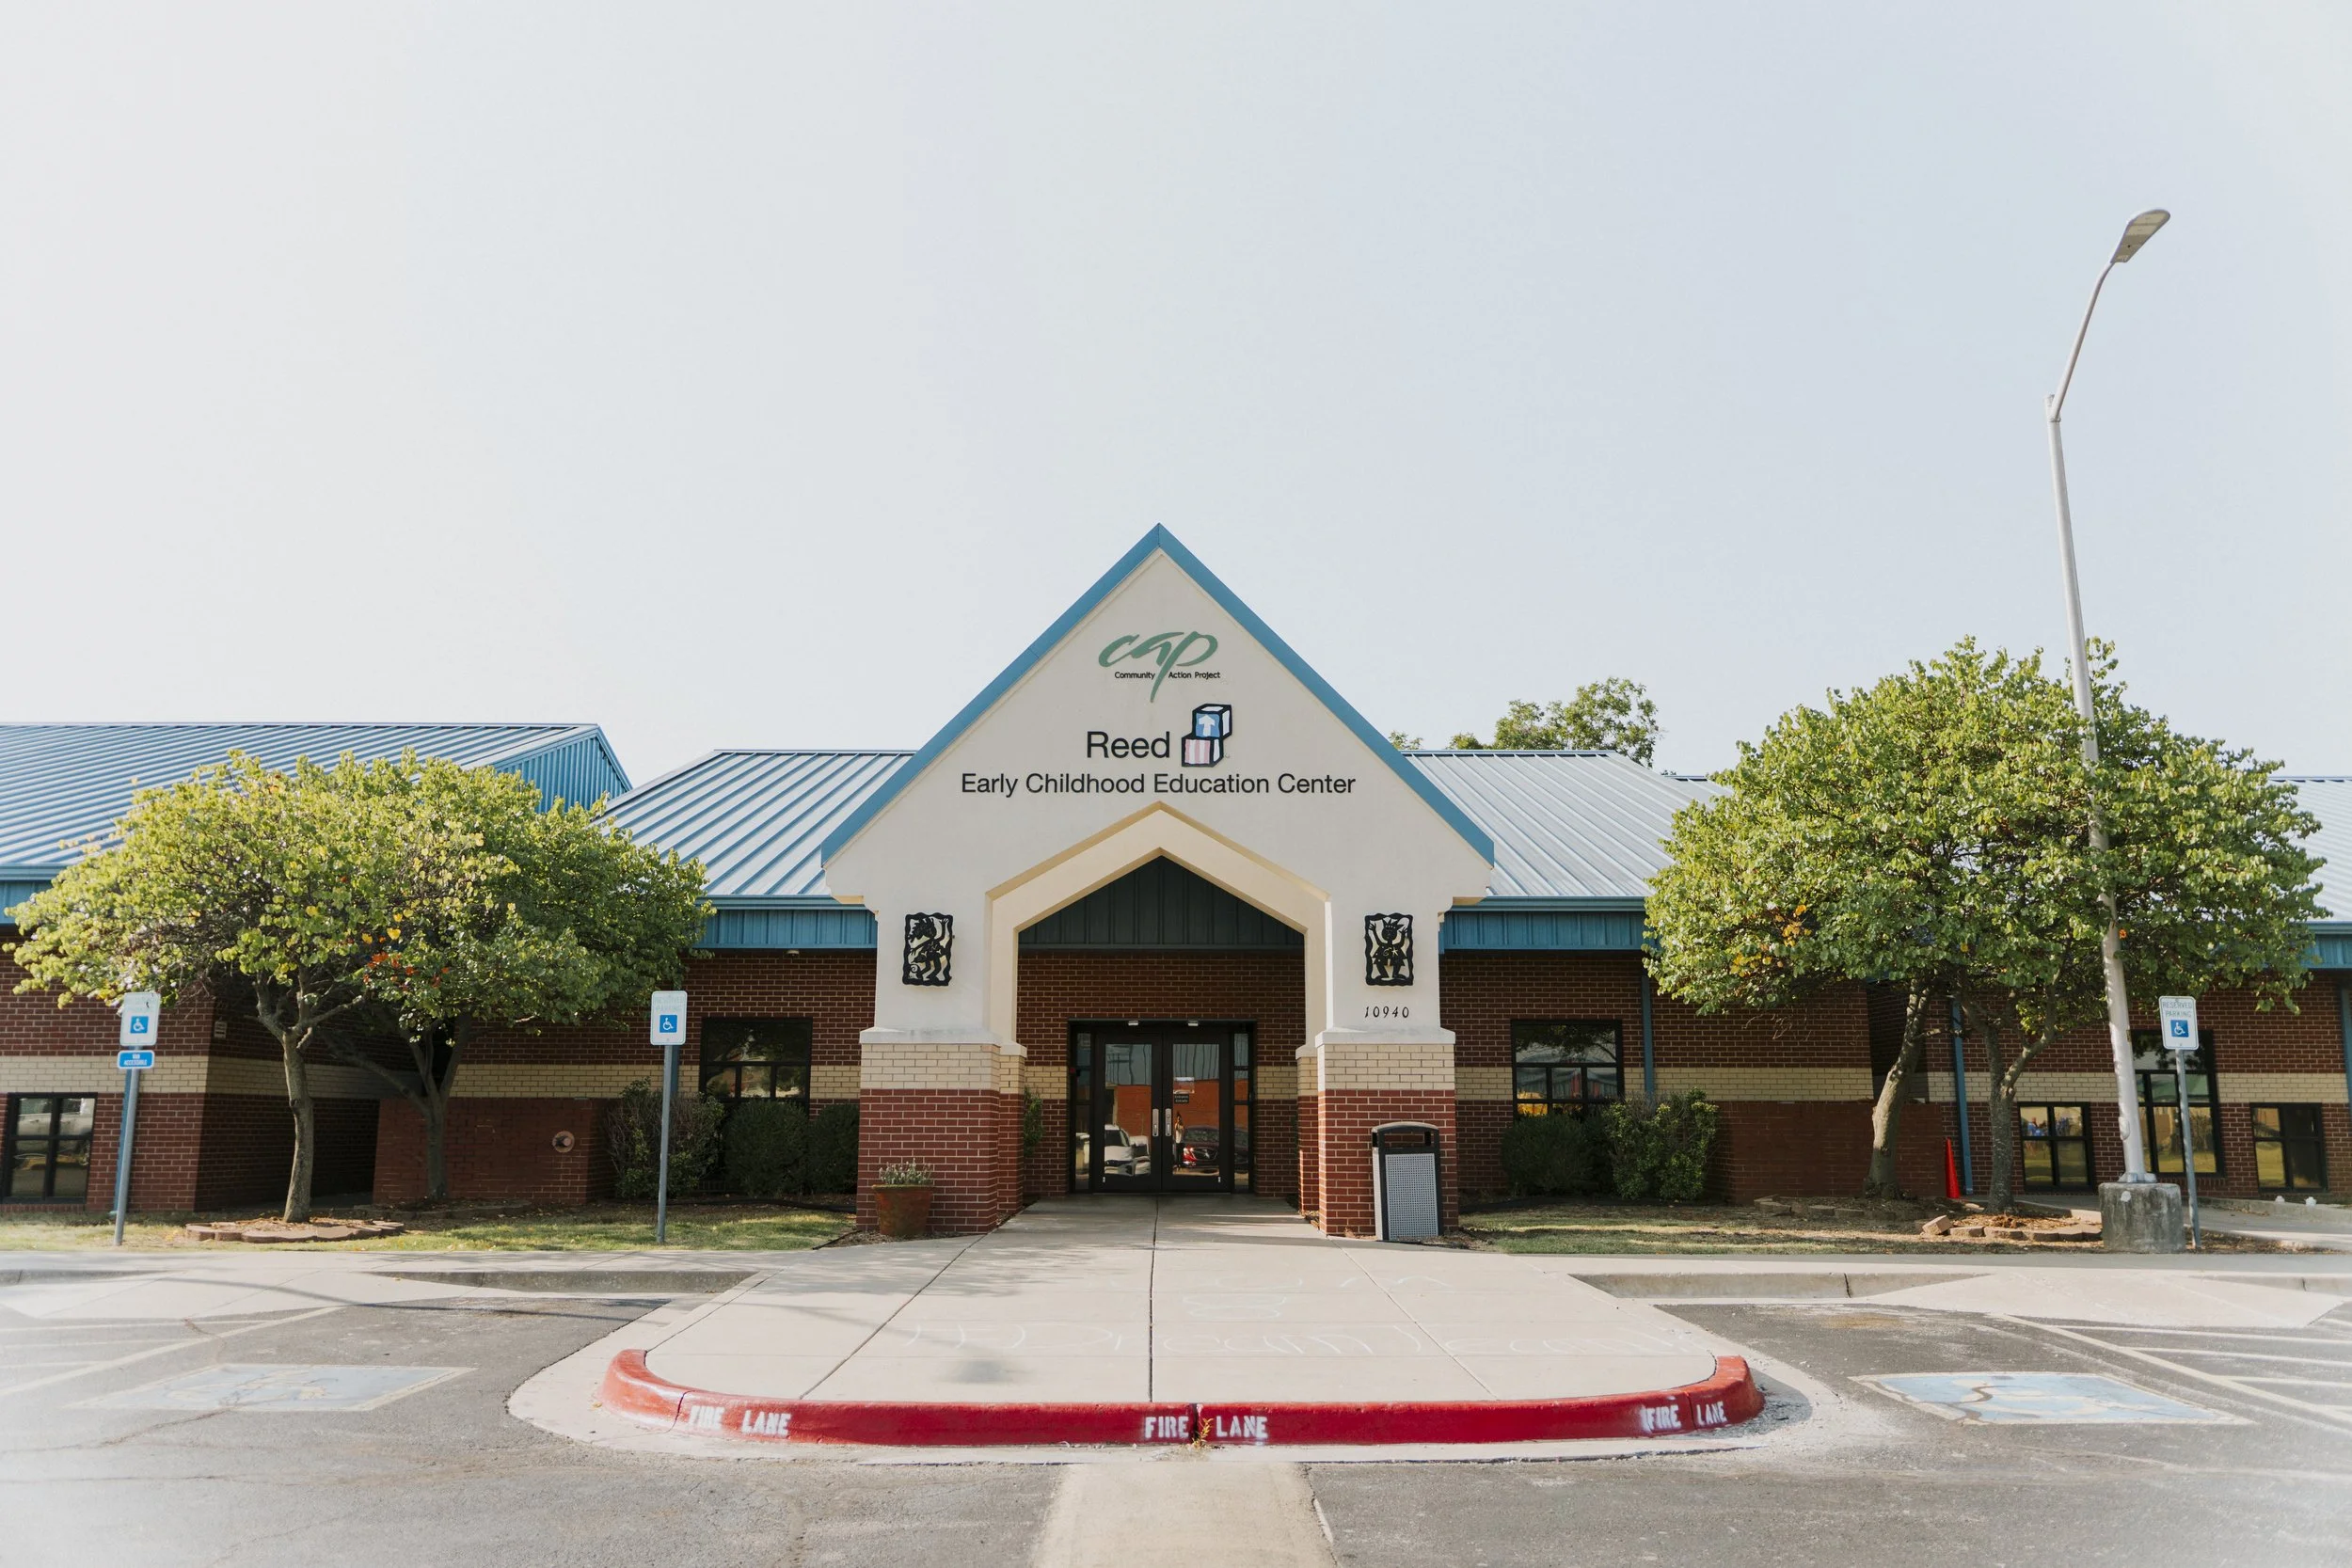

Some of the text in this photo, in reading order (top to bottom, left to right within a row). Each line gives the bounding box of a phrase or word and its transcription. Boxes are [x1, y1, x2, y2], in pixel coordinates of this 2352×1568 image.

[1114, 671, 1221, 680] Community Action Project
[1087, 731, 1170, 759] Reed
[961, 772, 1357, 799] Early Childhood Education Center
[1364, 1006, 1409, 1019] 10940
[2162, 1001, 2193, 1009] RESERVED
[2165, 1009, 2192, 1018] PARKING
[688, 1405, 791, 1437] FIRE LANE
[1145, 1415, 1268, 1439] FIRE LANE
[1643, 1401, 1727, 1431] FIRE LANE
